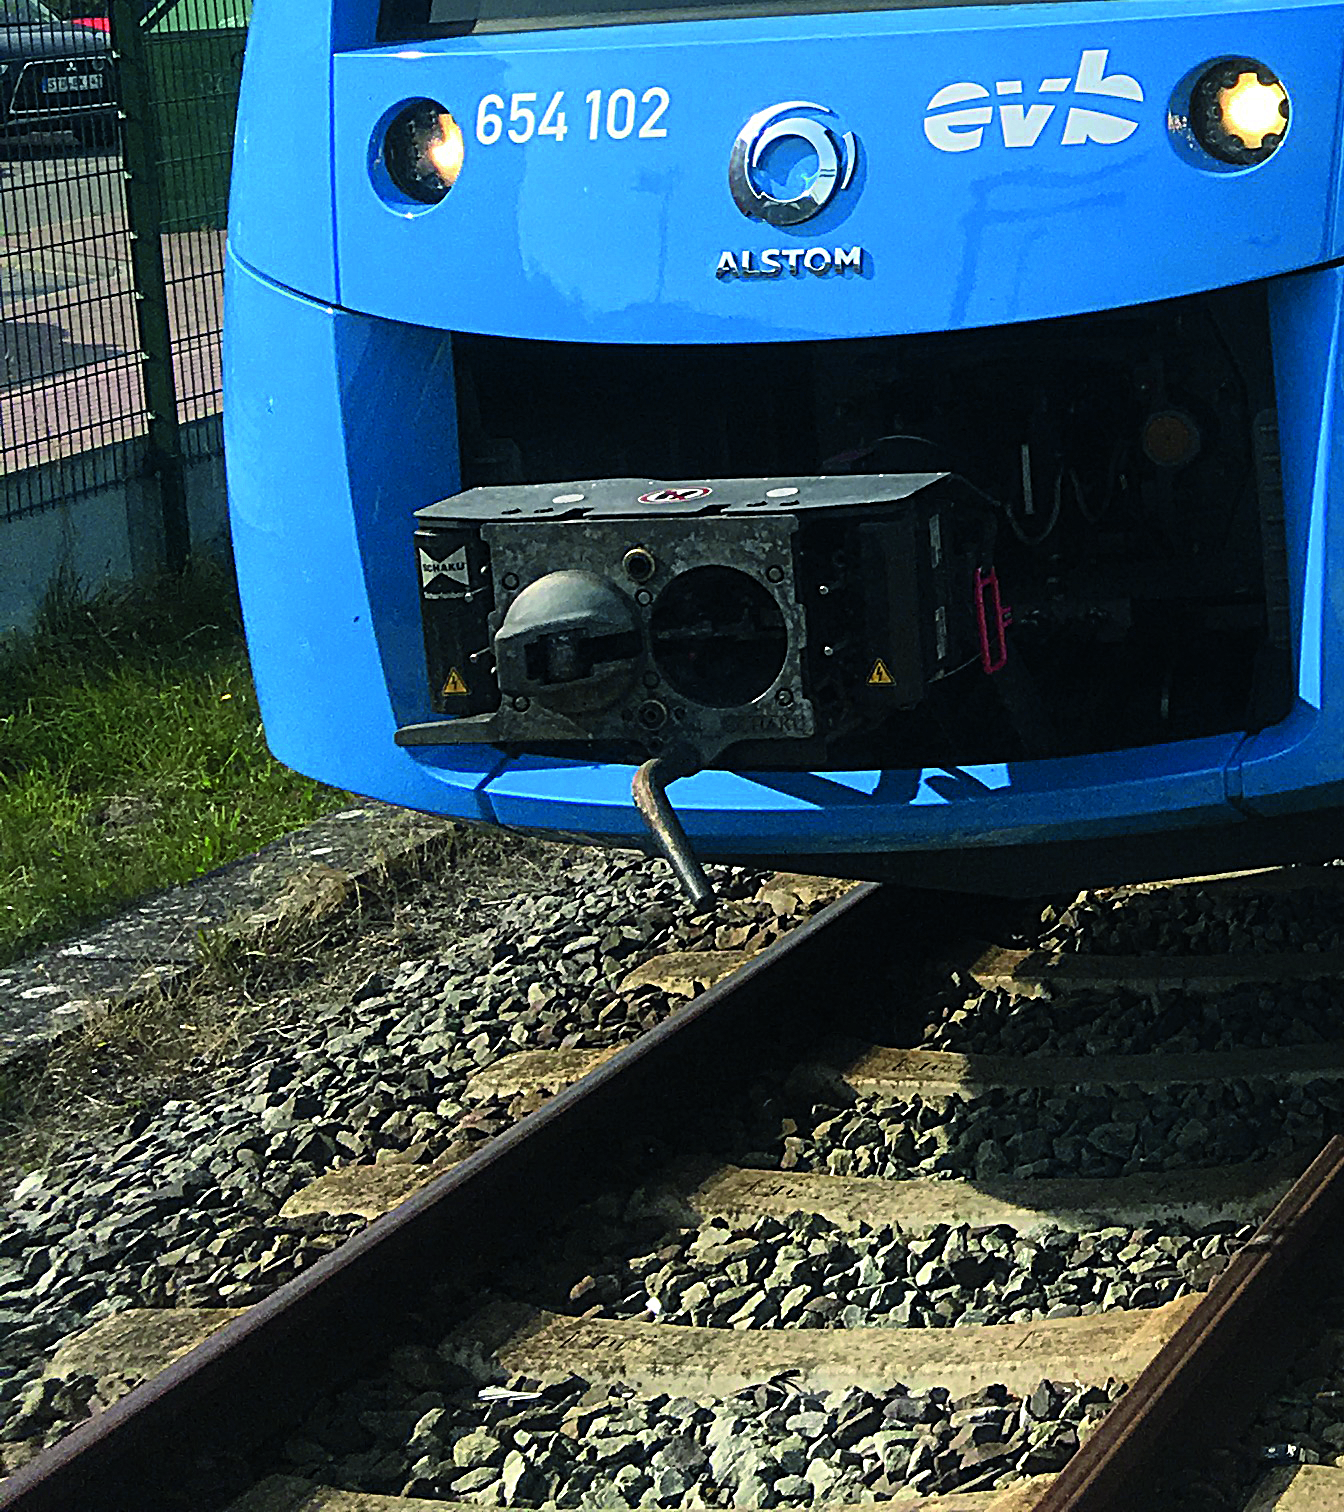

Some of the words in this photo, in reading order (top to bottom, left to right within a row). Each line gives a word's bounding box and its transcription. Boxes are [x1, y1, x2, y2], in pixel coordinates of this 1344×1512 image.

[475, 90, 568, 146] 654
[585, 85, 671, 141] 102
[923, 48, 1145, 153] evb
[714, 245, 864, 280] ALSTOM
[422, 562, 465, 573] SCHAKU
